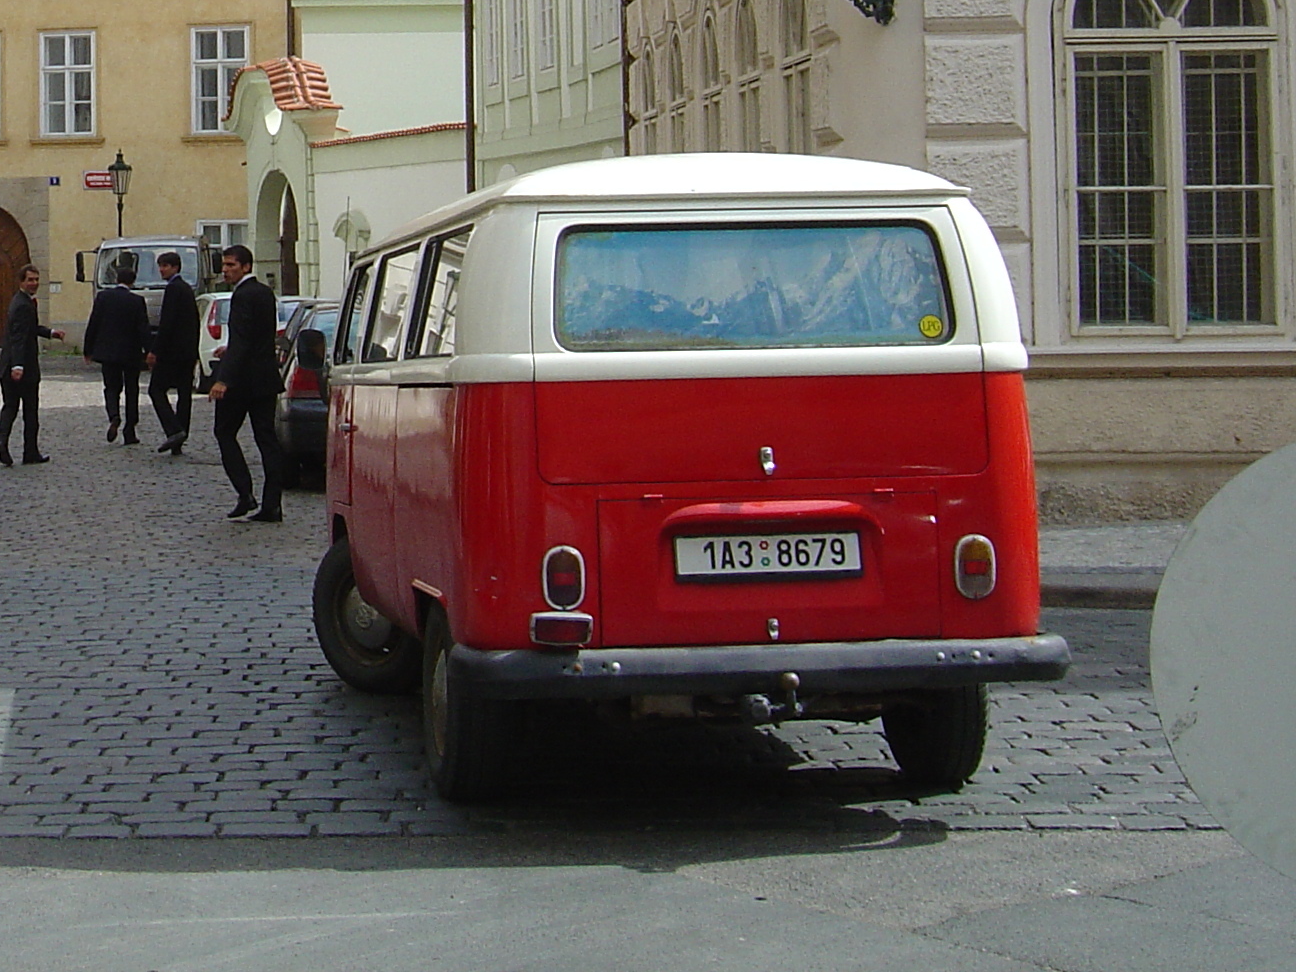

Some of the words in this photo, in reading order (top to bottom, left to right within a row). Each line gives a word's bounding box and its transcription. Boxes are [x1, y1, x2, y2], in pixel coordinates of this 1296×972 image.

[922, 321, 941, 331] LPG
[703, 541, 754, 570] 1A3
[776, 538, 846, 567] 8679
